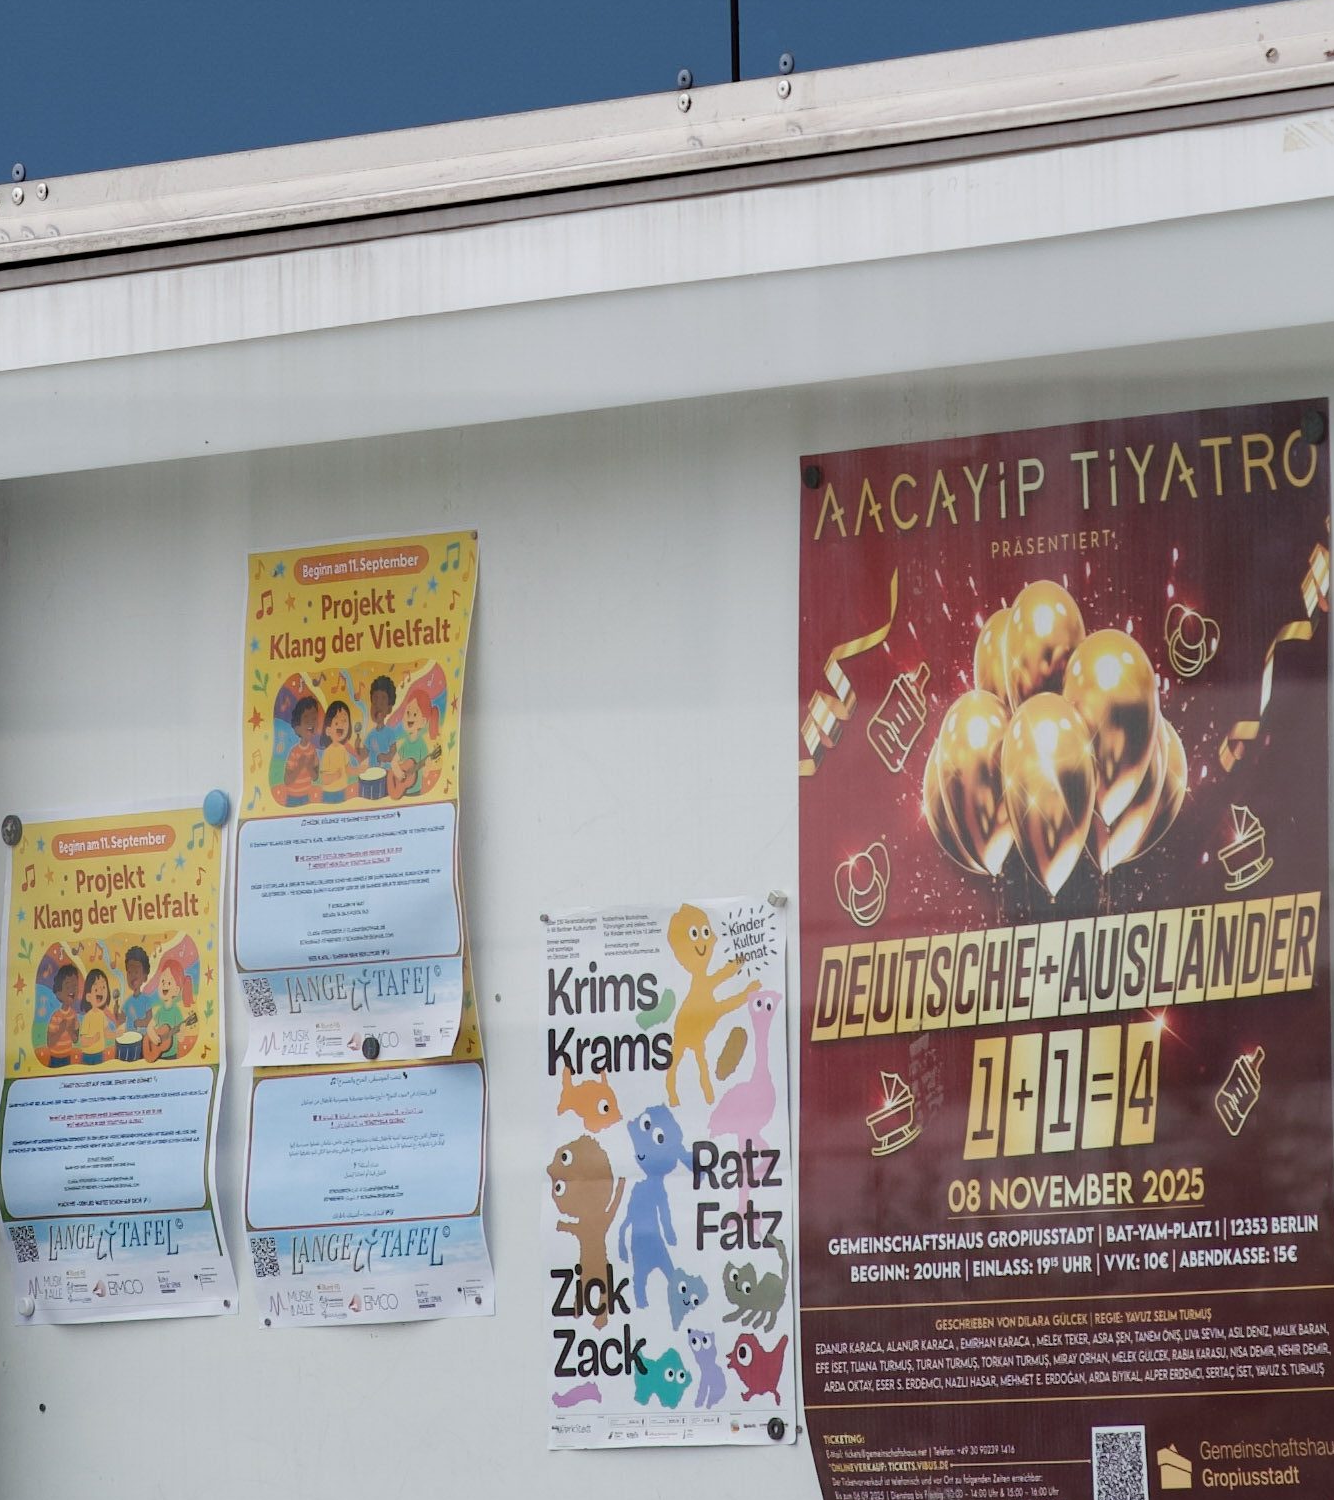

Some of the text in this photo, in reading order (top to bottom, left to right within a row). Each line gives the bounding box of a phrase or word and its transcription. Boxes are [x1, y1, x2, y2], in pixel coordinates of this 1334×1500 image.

[991, 529, 1111, 559] PRÄSENTIERT
[302, 563, 333, 581] Beginn
[334, 561, 348, 575] am
[359, 554, 419, 573] September
[321, 588, 395, 625] Projekt
[270, 617, 451, 663] Klang der Vielfalt
[58, 839, 86, 856] Beginn
[86, 839, 99, 851] am
[111, 832, 166, 850] September
[75, 865, 146, 898] Projekt
[33, 892, 199, 933] Klang der Vielfalt
[727, 917, 766, 936] Kinder
[733, 931, 766, 950] Kultur
[734, 944, 769, 965] Monat
[285, 973, 348, 1014] LANGE
[548, 961, 659, 1016] Krims
[548, 1027, 673, 1076] Krams
[692, 1138, 783, 1190] Ratz
[947, 1167, 1205, 1213] 08 NOVEMBER 2025
[48, 1223, 95, 1261] LANGE
[696, 1200, 783, 1251] Fatz
[828, 1232, 984, 1256] GEMEINSCHAFTSHAUS
[986, 1226, 1095, 1248] GROPIUSSTADT
[1106, 1220, 1213, 1243] BAT-YAM-PLATZ
[1230, 1217, 1269, 1236] 12353
[1271, 1214, 1318, 1234] BERLIN
[292, 1233, 353, 1275] LANGE
[850, 1263, 910, 1282] BEGINN:
[913, 1260, 962, 1281] 20UHR
[972, 1257, 1034, 1278] EINLASS:
[1062, 1254, 1092, 1275] UHR
[1104, 1252, 1140, 1272] VVK:
[1144, 1251, 1169, 1270] 10€
[1179, 1246, 1270, 1268] ABENDKASSE:
[1273, 1244, 1298, 1264] 15€
[550, 1263, 631, 1317] Zick
[935, 1316, 994, 1332] GESCHRIEBEN
[997, 1315, 1015, 1328] VON
[1095, 1312, 1123, 1325] REGIE:
[1125, 1310, 1152, 1323] YAVUZ
[554, 1324, 648, 1378] Zack
[815, 1342, 848, 1355] EDANUR
[886, 1340, 919, 1352] ALANUR
[1036, 1334, 1063, 1346] MELEK
[824, 1380, 846, 1393] ARDA
[875, 1378, 896, 1391] ESER
[1000, 1373, 1034, 1387] MEHMET
[1089, 1371, 1110, 1384] ARDA
[1144, 1368, 1169, 1381] ALPER
[1255, 1363, 1280, 1377] YAVUZ
[916, 1358, 944, 1371] TURAN
[1201, 1466, 1301, 1490] Gropiusstadt
